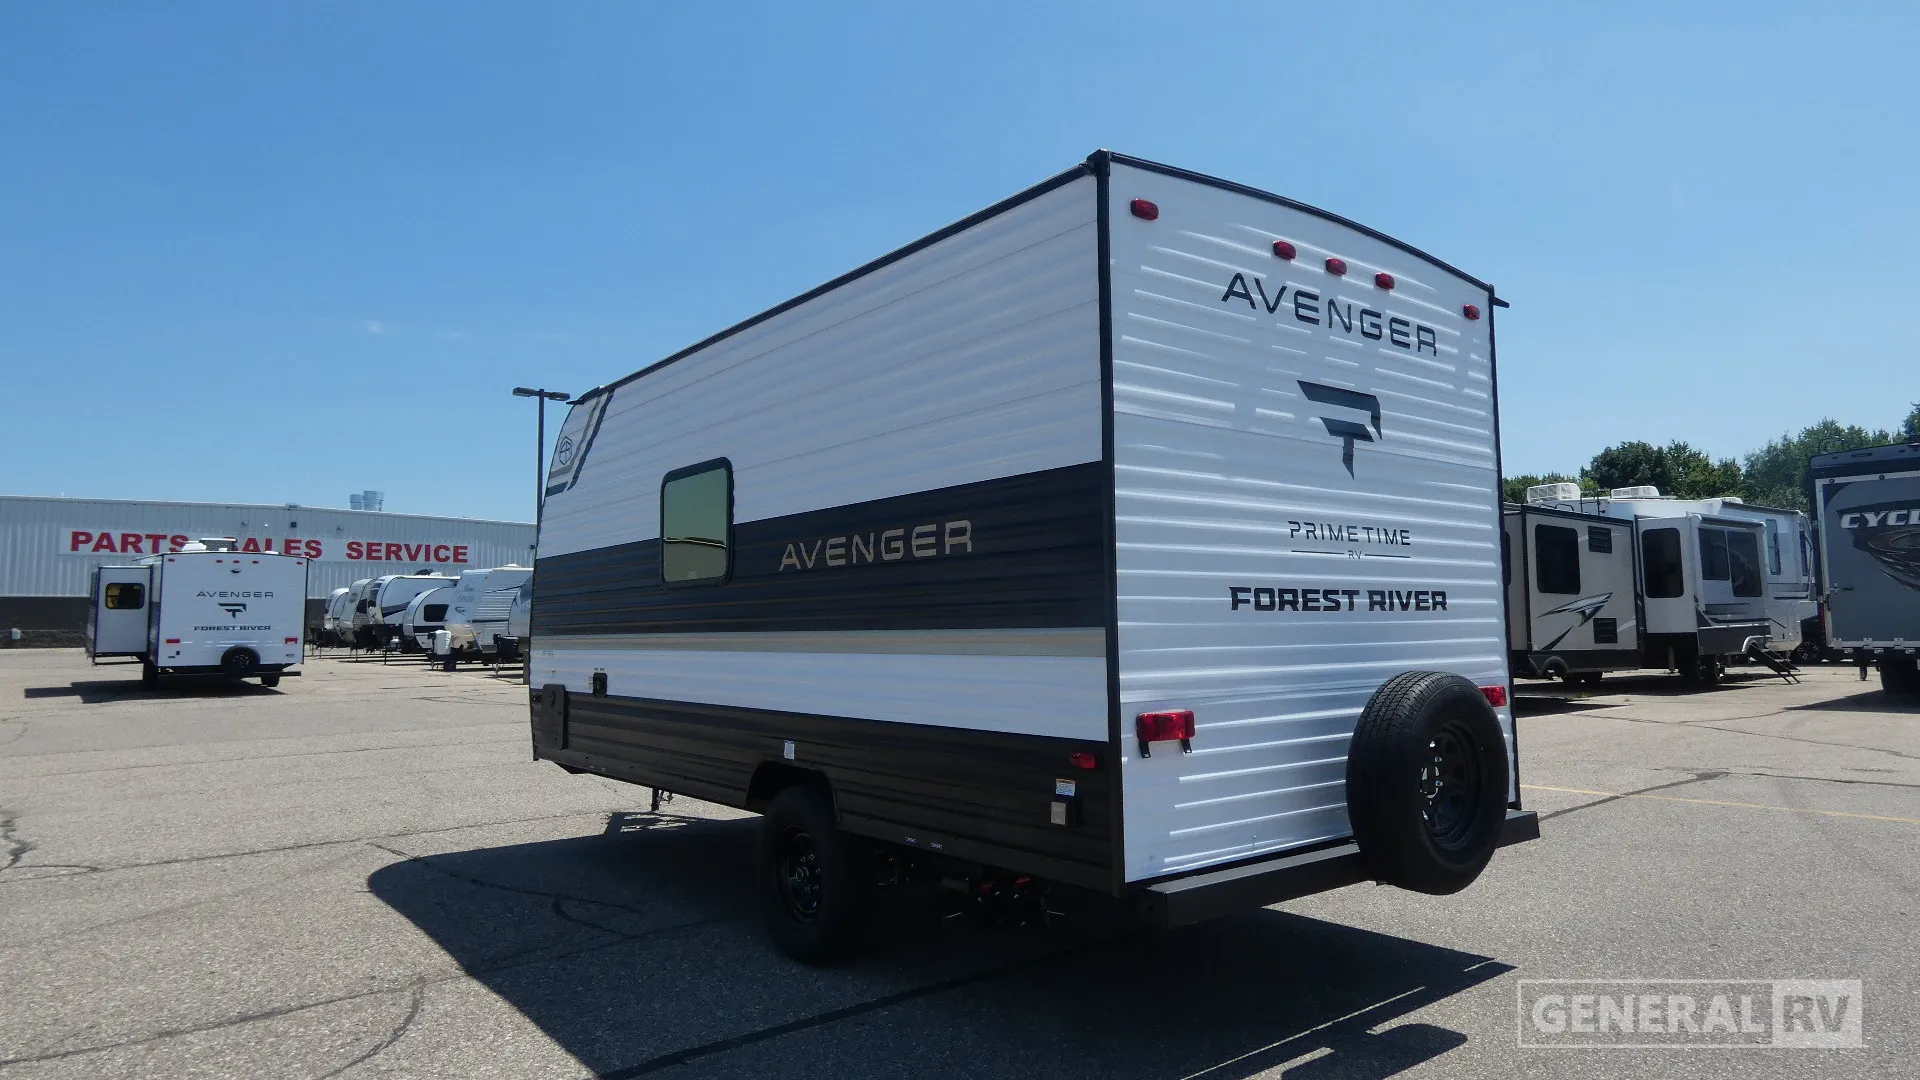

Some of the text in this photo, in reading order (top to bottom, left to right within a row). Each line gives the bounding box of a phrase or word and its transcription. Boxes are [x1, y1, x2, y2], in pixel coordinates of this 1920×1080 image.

[1221, 272, 1437, 357] AVENGER
[70, 531, 190, 553] PARTS
[345, 541, 468, 563] SERVICE
[779, 519, 972, 572] AVENGER
[1347, 549, 1362, 560] RV
[196, 591, 274, 599] AVENGER
[1229, 586, 1448, 612] FOREST RIVER
